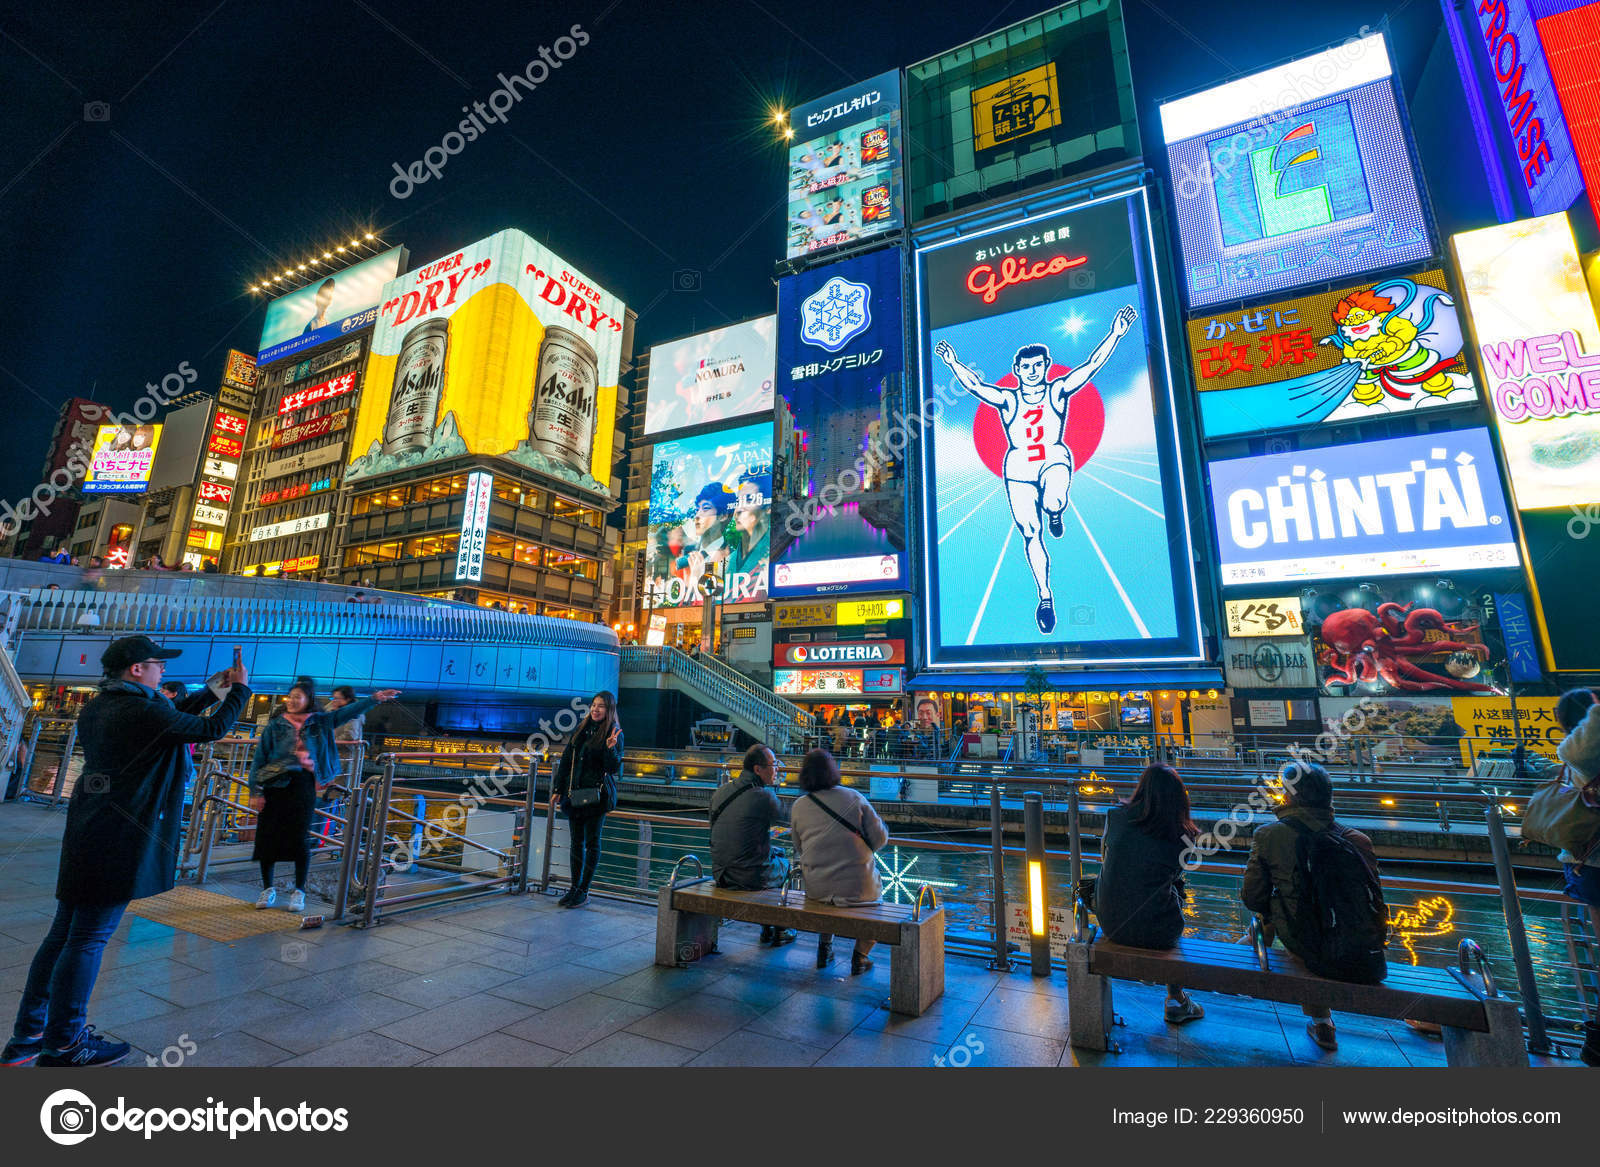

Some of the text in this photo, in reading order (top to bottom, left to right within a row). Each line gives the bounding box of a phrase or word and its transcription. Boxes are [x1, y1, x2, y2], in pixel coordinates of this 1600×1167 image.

[807, 90, 882, 128] ピップエレキバン
[994, 99, 1032, 121] 7-8F
[975, 226, 1071, 262] おいしさと健康
[415, 252, 464, 285] SUPER
[559, 269, 602, 305] SUPER
[351, 308, 380, 328] フジ住
[1203, 307, 1301, 341] かぜに
[789, 348, 884, 381] 雪印メグミルク
[1196, 325, 1319, 380] 改源
[1482, 329, 1600, 381] WEL
[393, 363, 440, 404] Asahi
[694, 361, 746, 384] NOMURA
[405, 401, 420, 416] 生
[540, 372, 593, 418] Asahi
[1495, 368, 1600, 422] COME
[557, 412, 572, 429] 生
[1022, 404, 1047, 463] グリコ
[707, 442, 773, 482] JAPAN
[1227, 446, 1489, 549] CHINTAI
[458, 526, 471, 577] かに道楽
[469, 527, 485, 577] かに道楽
[1240, 603, 1288, 631] くくる
[444, 659, 538, 683] えびす橋
[810, 646, 883, 660] LOTTERIA
[1473, 707, 1560, 723] 从这里到大
